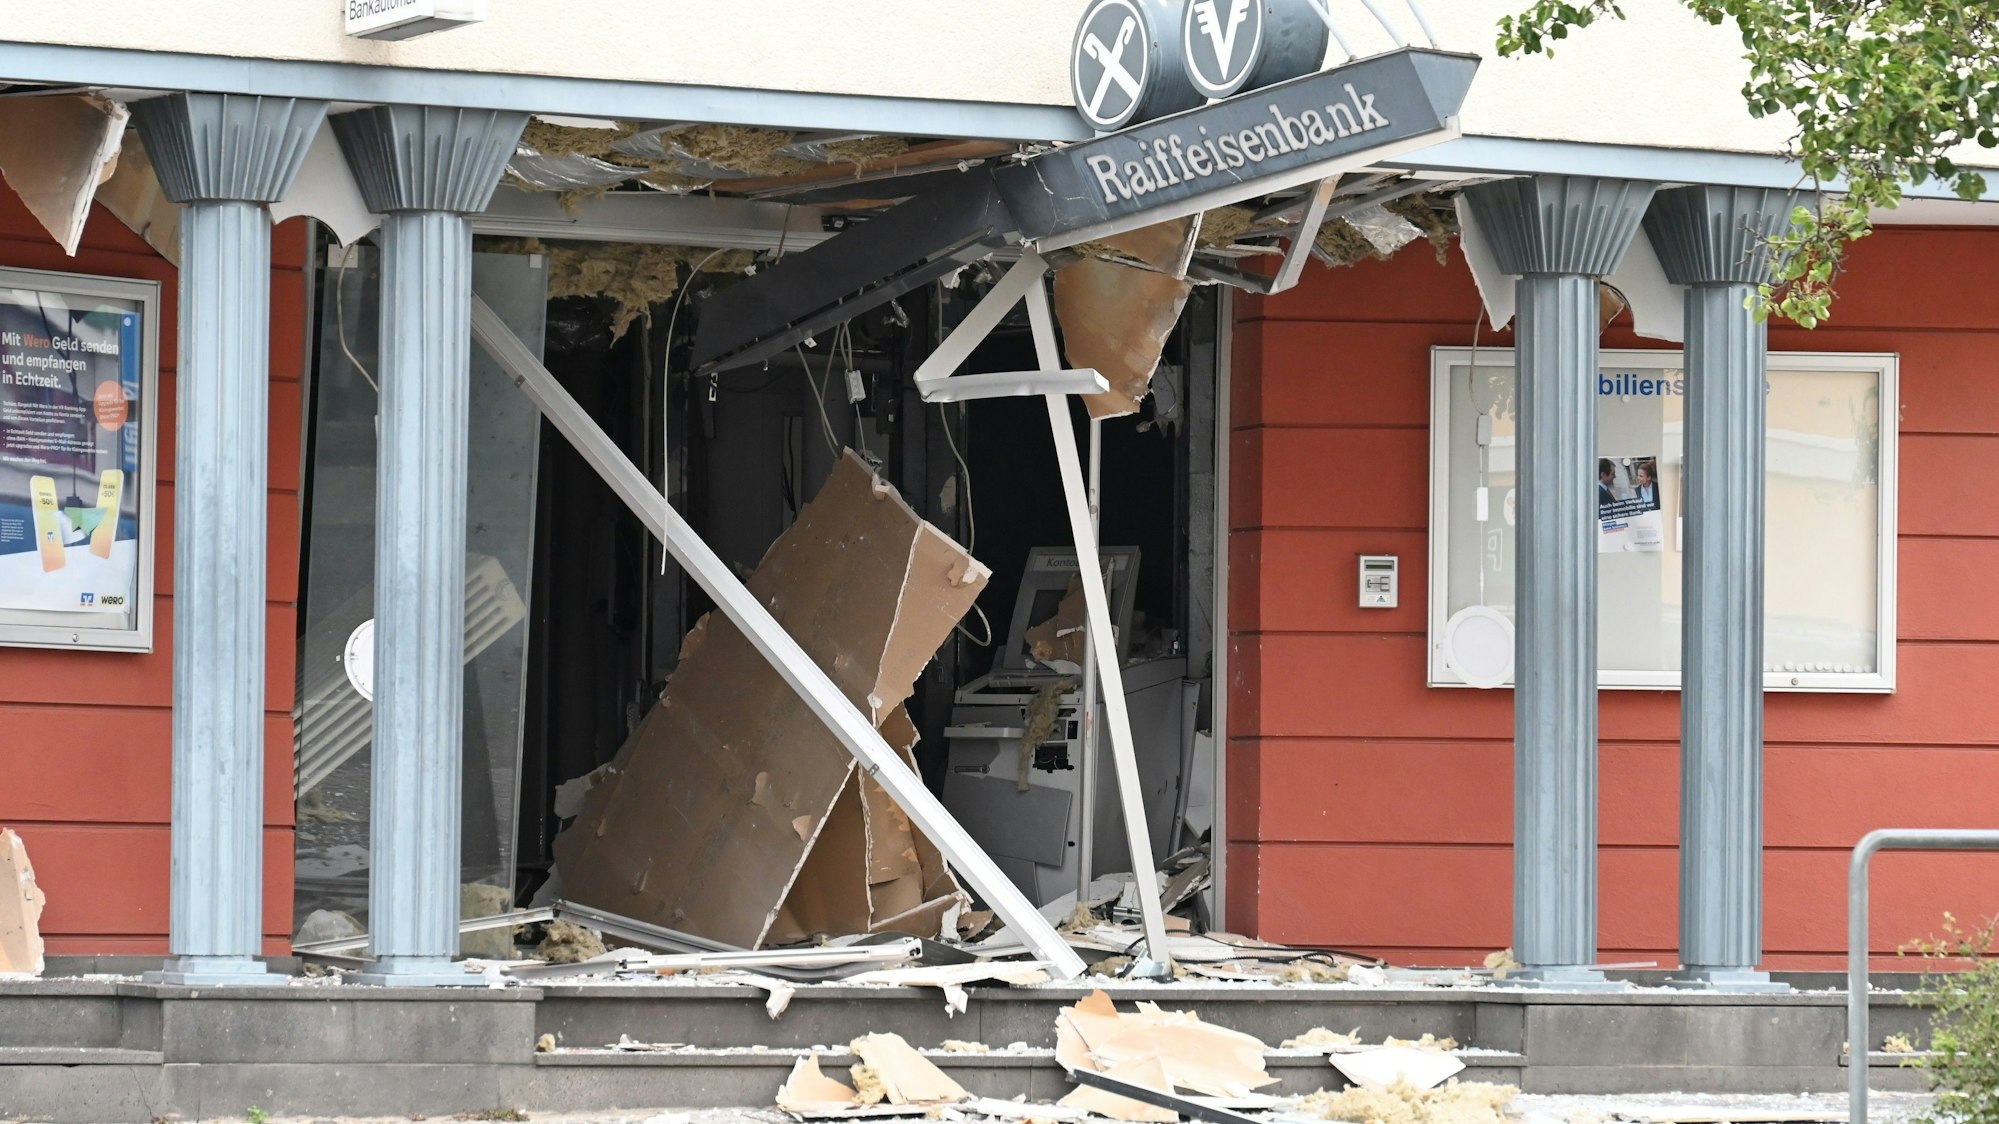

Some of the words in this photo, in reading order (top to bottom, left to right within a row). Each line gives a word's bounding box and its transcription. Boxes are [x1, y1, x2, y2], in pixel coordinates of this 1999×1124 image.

[349, 0, 416, 20] Bankautom
[1086, 83, 1389, 204] Raiffeisenbank
[2, 332, 21, 346] Mit
[23, 334, 50, 348] Wero
[52, 336, 78, 351] Geld
[80, 340, 119, 354] senden
[2, 352, 24, 366] und
[26, 355, 86, 373] empfangen
[2, 370, 12, 384] in
[15, 372, 62, 388] Echtzeit.
[1599, 374, 1684, 396] biliens
